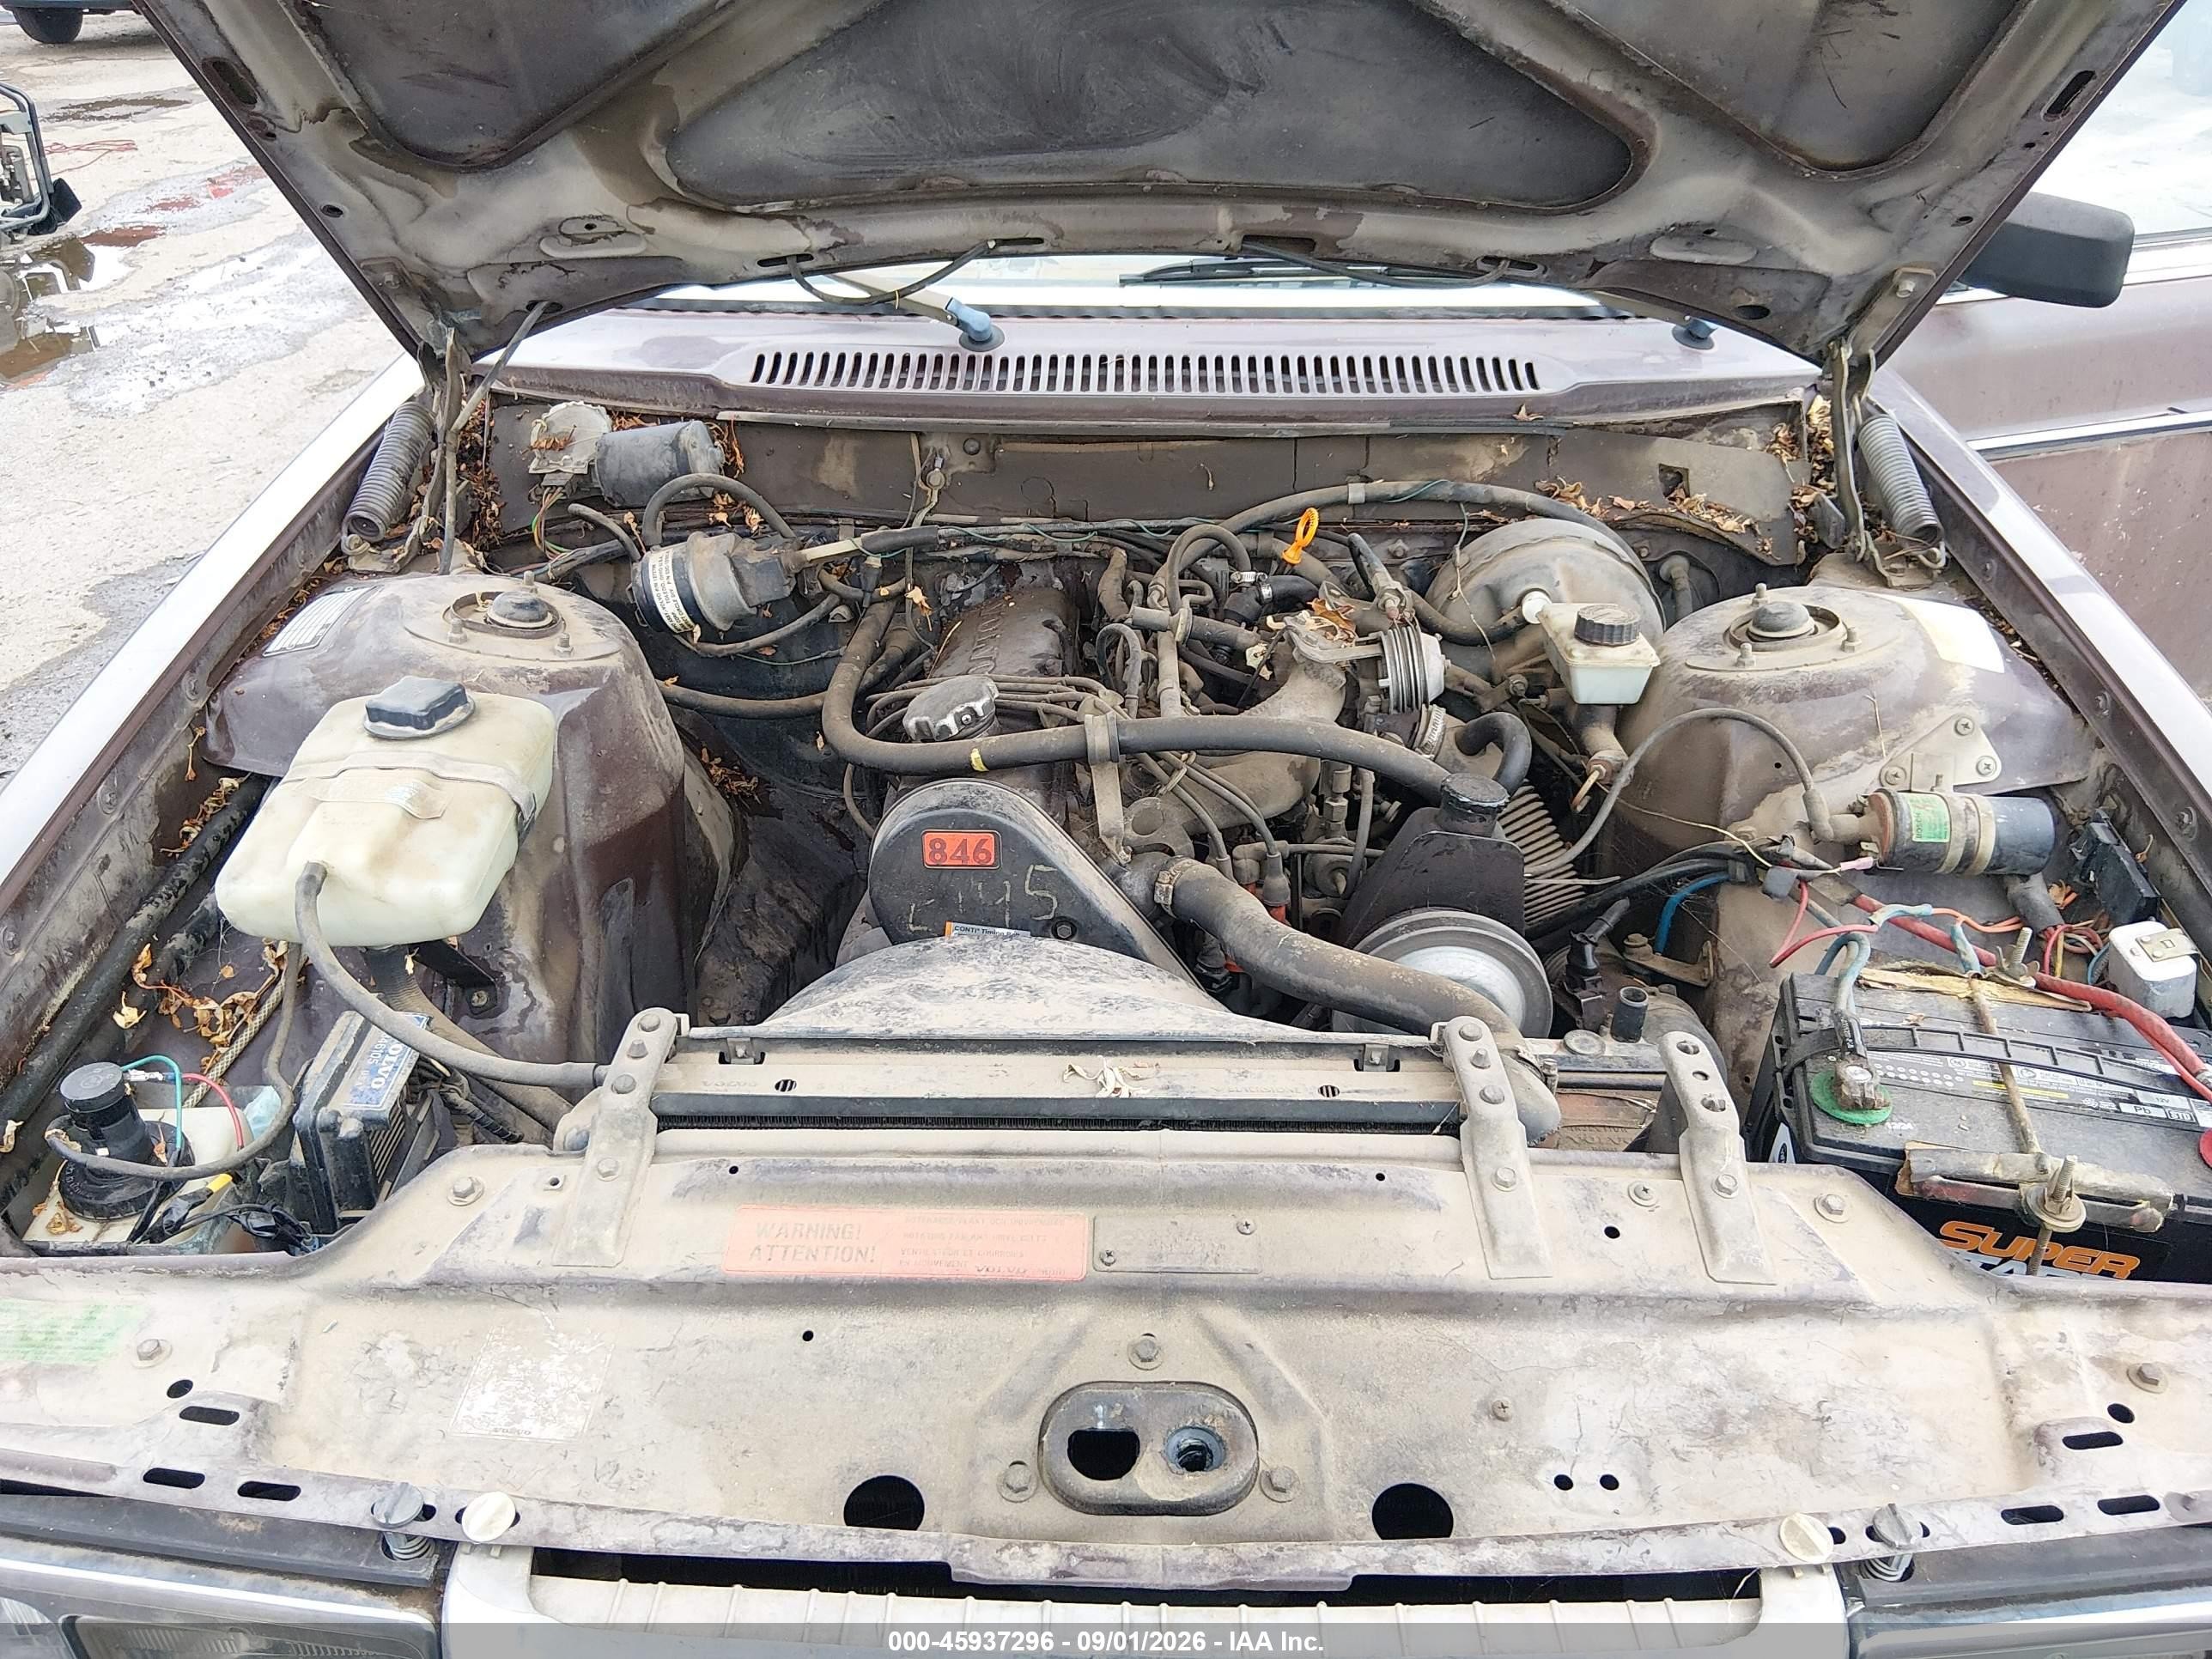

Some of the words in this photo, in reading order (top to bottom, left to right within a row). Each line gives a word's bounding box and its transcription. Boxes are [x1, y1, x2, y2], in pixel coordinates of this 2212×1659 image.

[927, 837, 993, 866] 846
[371, 1042, 403, 1090] OLVO
[2134, 1105, 2152, 1115] Pb
[756, 1222, 861, 1241] WARNING!
[749, 1245, 876, 1264] ATTENTION!
[1939, 1220, 2142, 1280] SUPER
